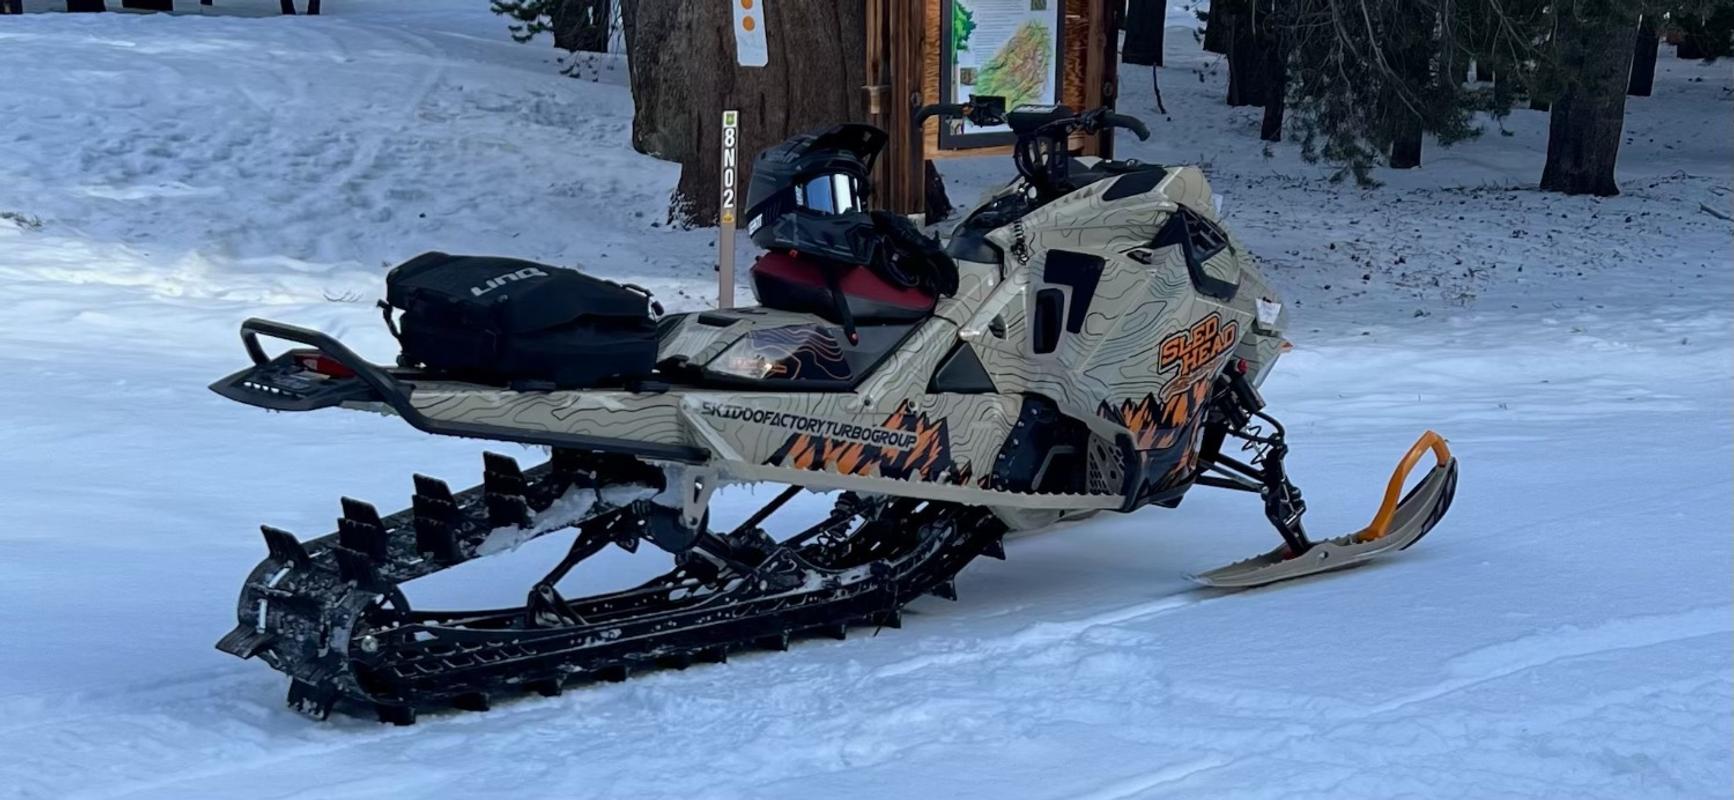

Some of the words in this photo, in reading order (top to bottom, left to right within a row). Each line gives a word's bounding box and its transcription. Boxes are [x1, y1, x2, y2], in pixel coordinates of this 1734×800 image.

[723, 127, 736, 208] 8N02
[470, 267, 549, 297] LINQ
[1160, 315, 1219, 368] SLED
[1180, 323, 1237, 377] HEAD
